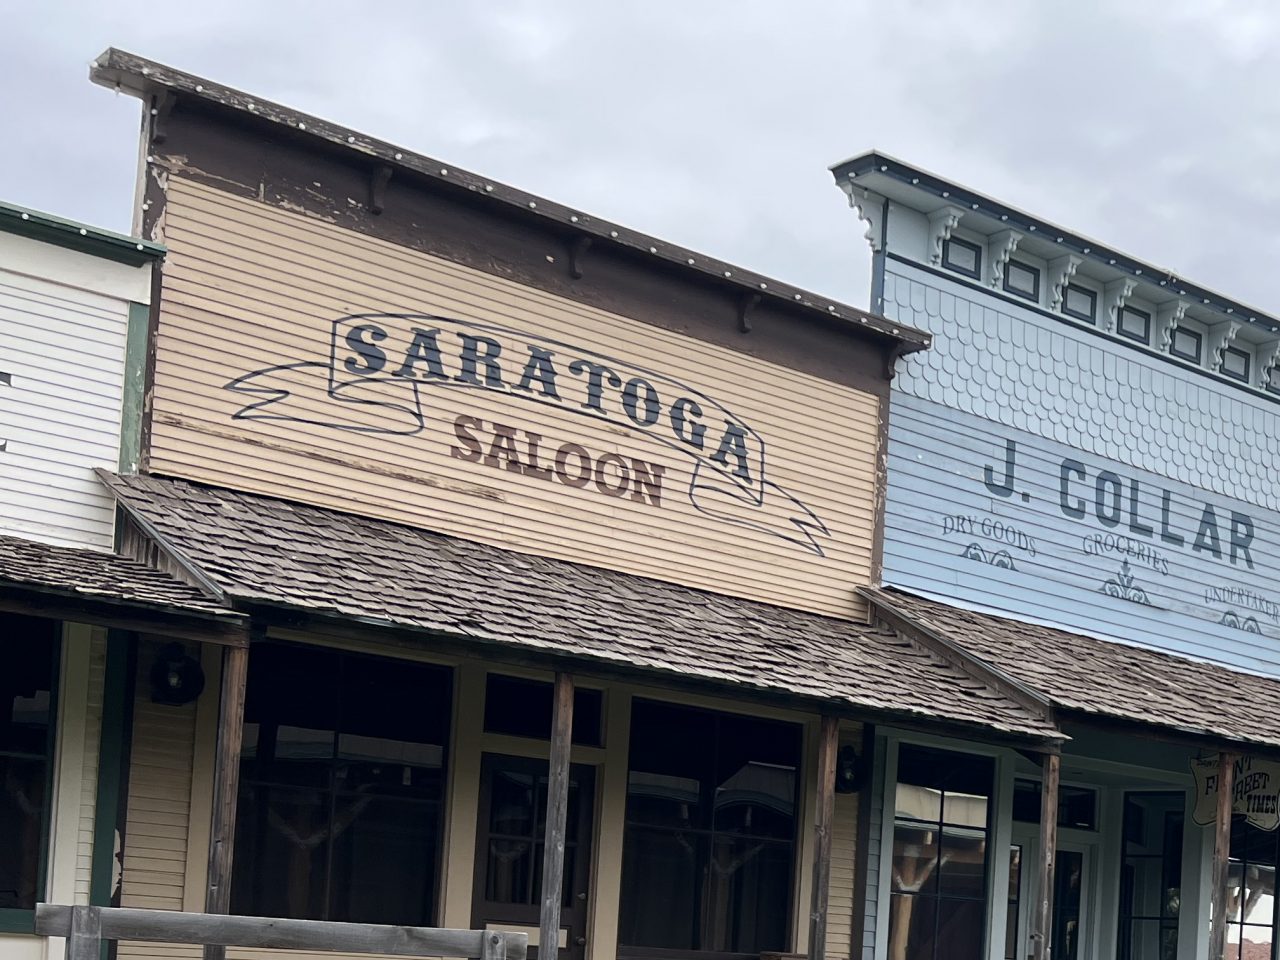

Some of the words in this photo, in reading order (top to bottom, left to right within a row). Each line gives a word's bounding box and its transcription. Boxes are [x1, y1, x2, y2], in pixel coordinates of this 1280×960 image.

[344, 322, 752, 481] SARATOGA
[450, 414, 666, 507] SALOON
[984, 440, 1030, 503] J.
[1059, 457, 1256, 570] COLLAR
[942, 515, 978, 536] DRY
[981, 517, 1037, 558] GOODS
[1082, 534, 1170, 577] GROCERIES
[1204, 585, 1280, 624] UNDERTAKER
[1246, 794, 1277, 814] TIMES
